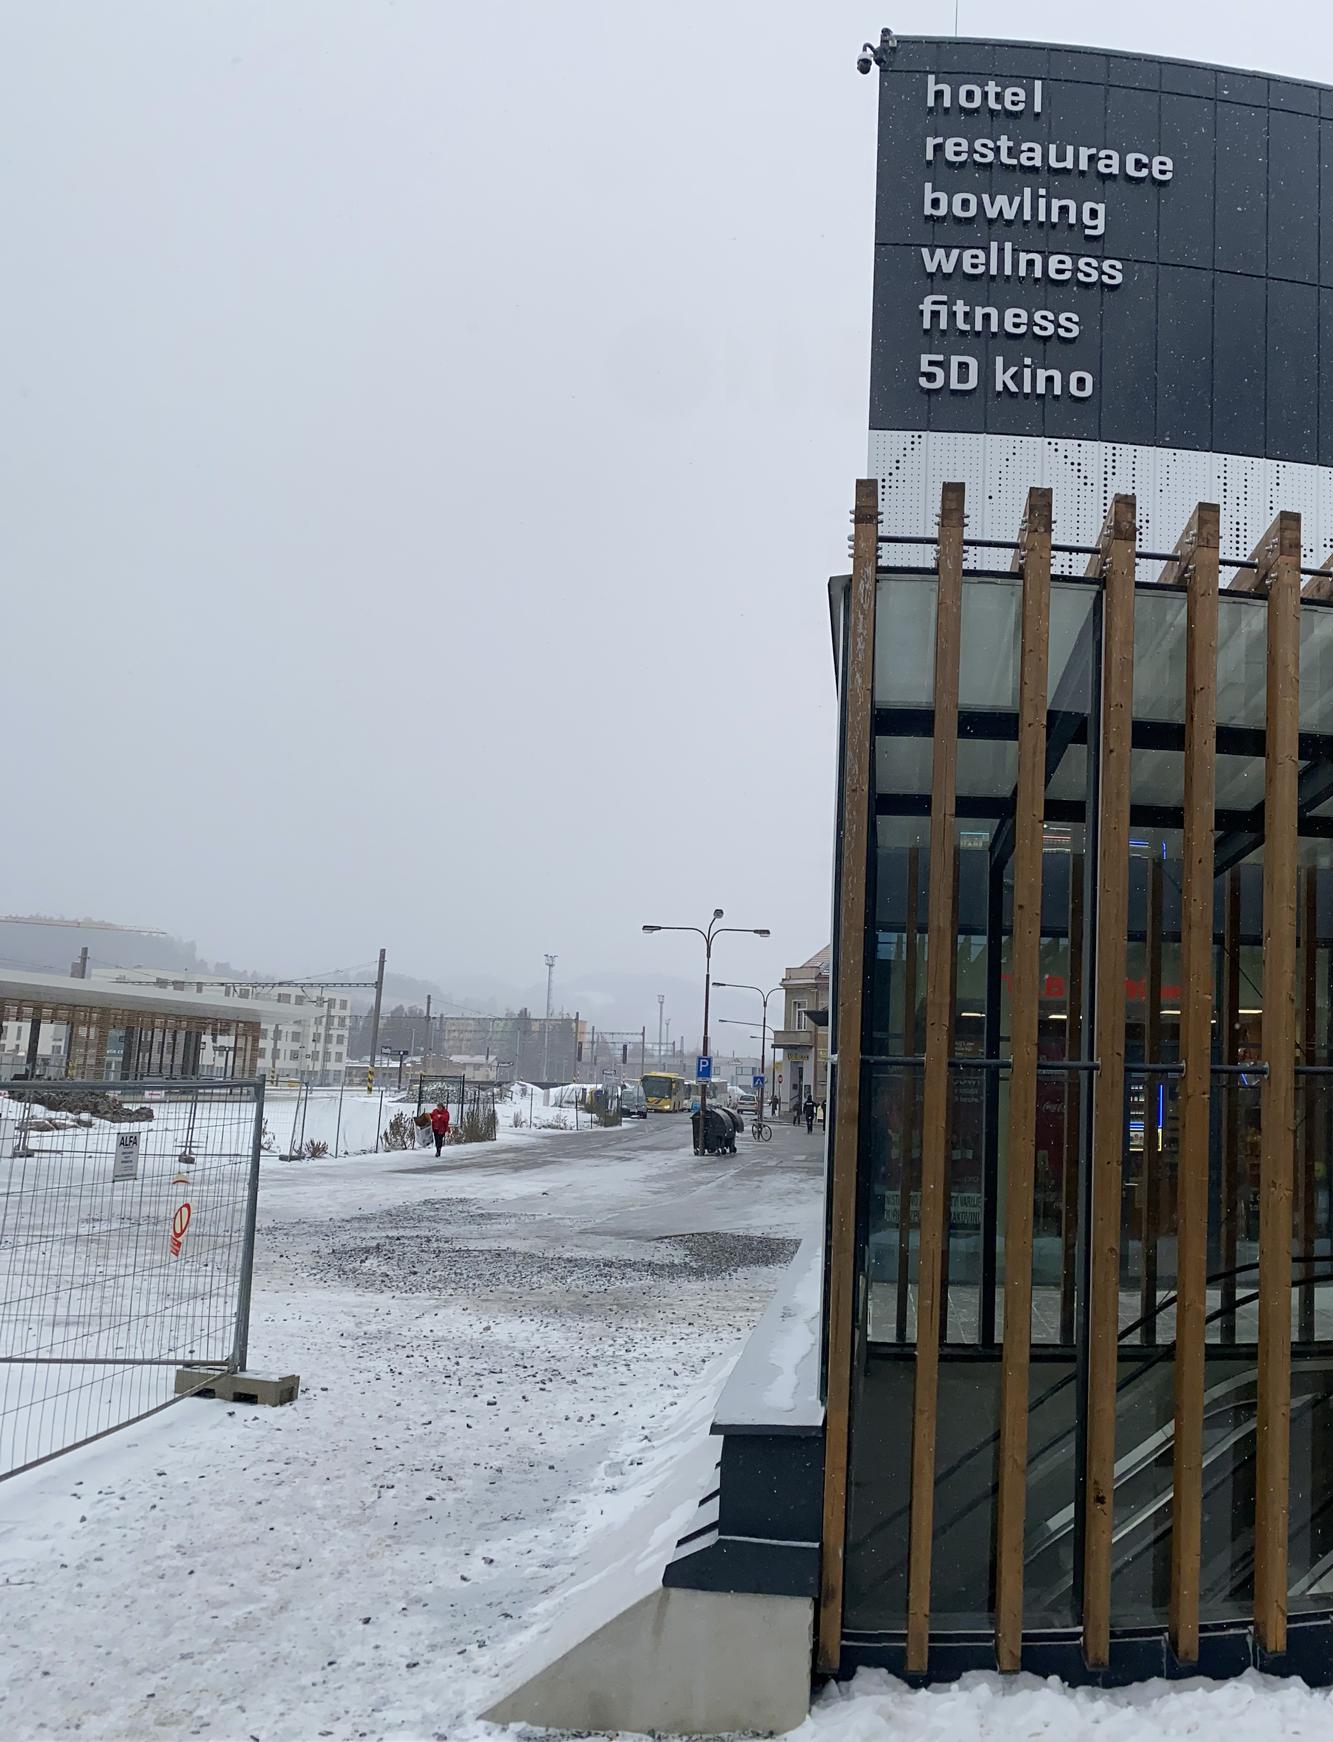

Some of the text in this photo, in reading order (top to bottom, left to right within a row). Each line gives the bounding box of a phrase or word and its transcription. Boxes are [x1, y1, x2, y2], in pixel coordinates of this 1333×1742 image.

[926, 74, 1042, 114] hotel
[925, 134, 1175, 182] restaurace
[923, 182, 1106, 236] bowling
[921, 241, 1124, 286] wellness
[919, 294, 1081, 339] fitness
[918, 353, 1095, 398] 5D kino
[699, 1058, 710, 1072] P
[119, 1135, 138, 1147] ALFA
